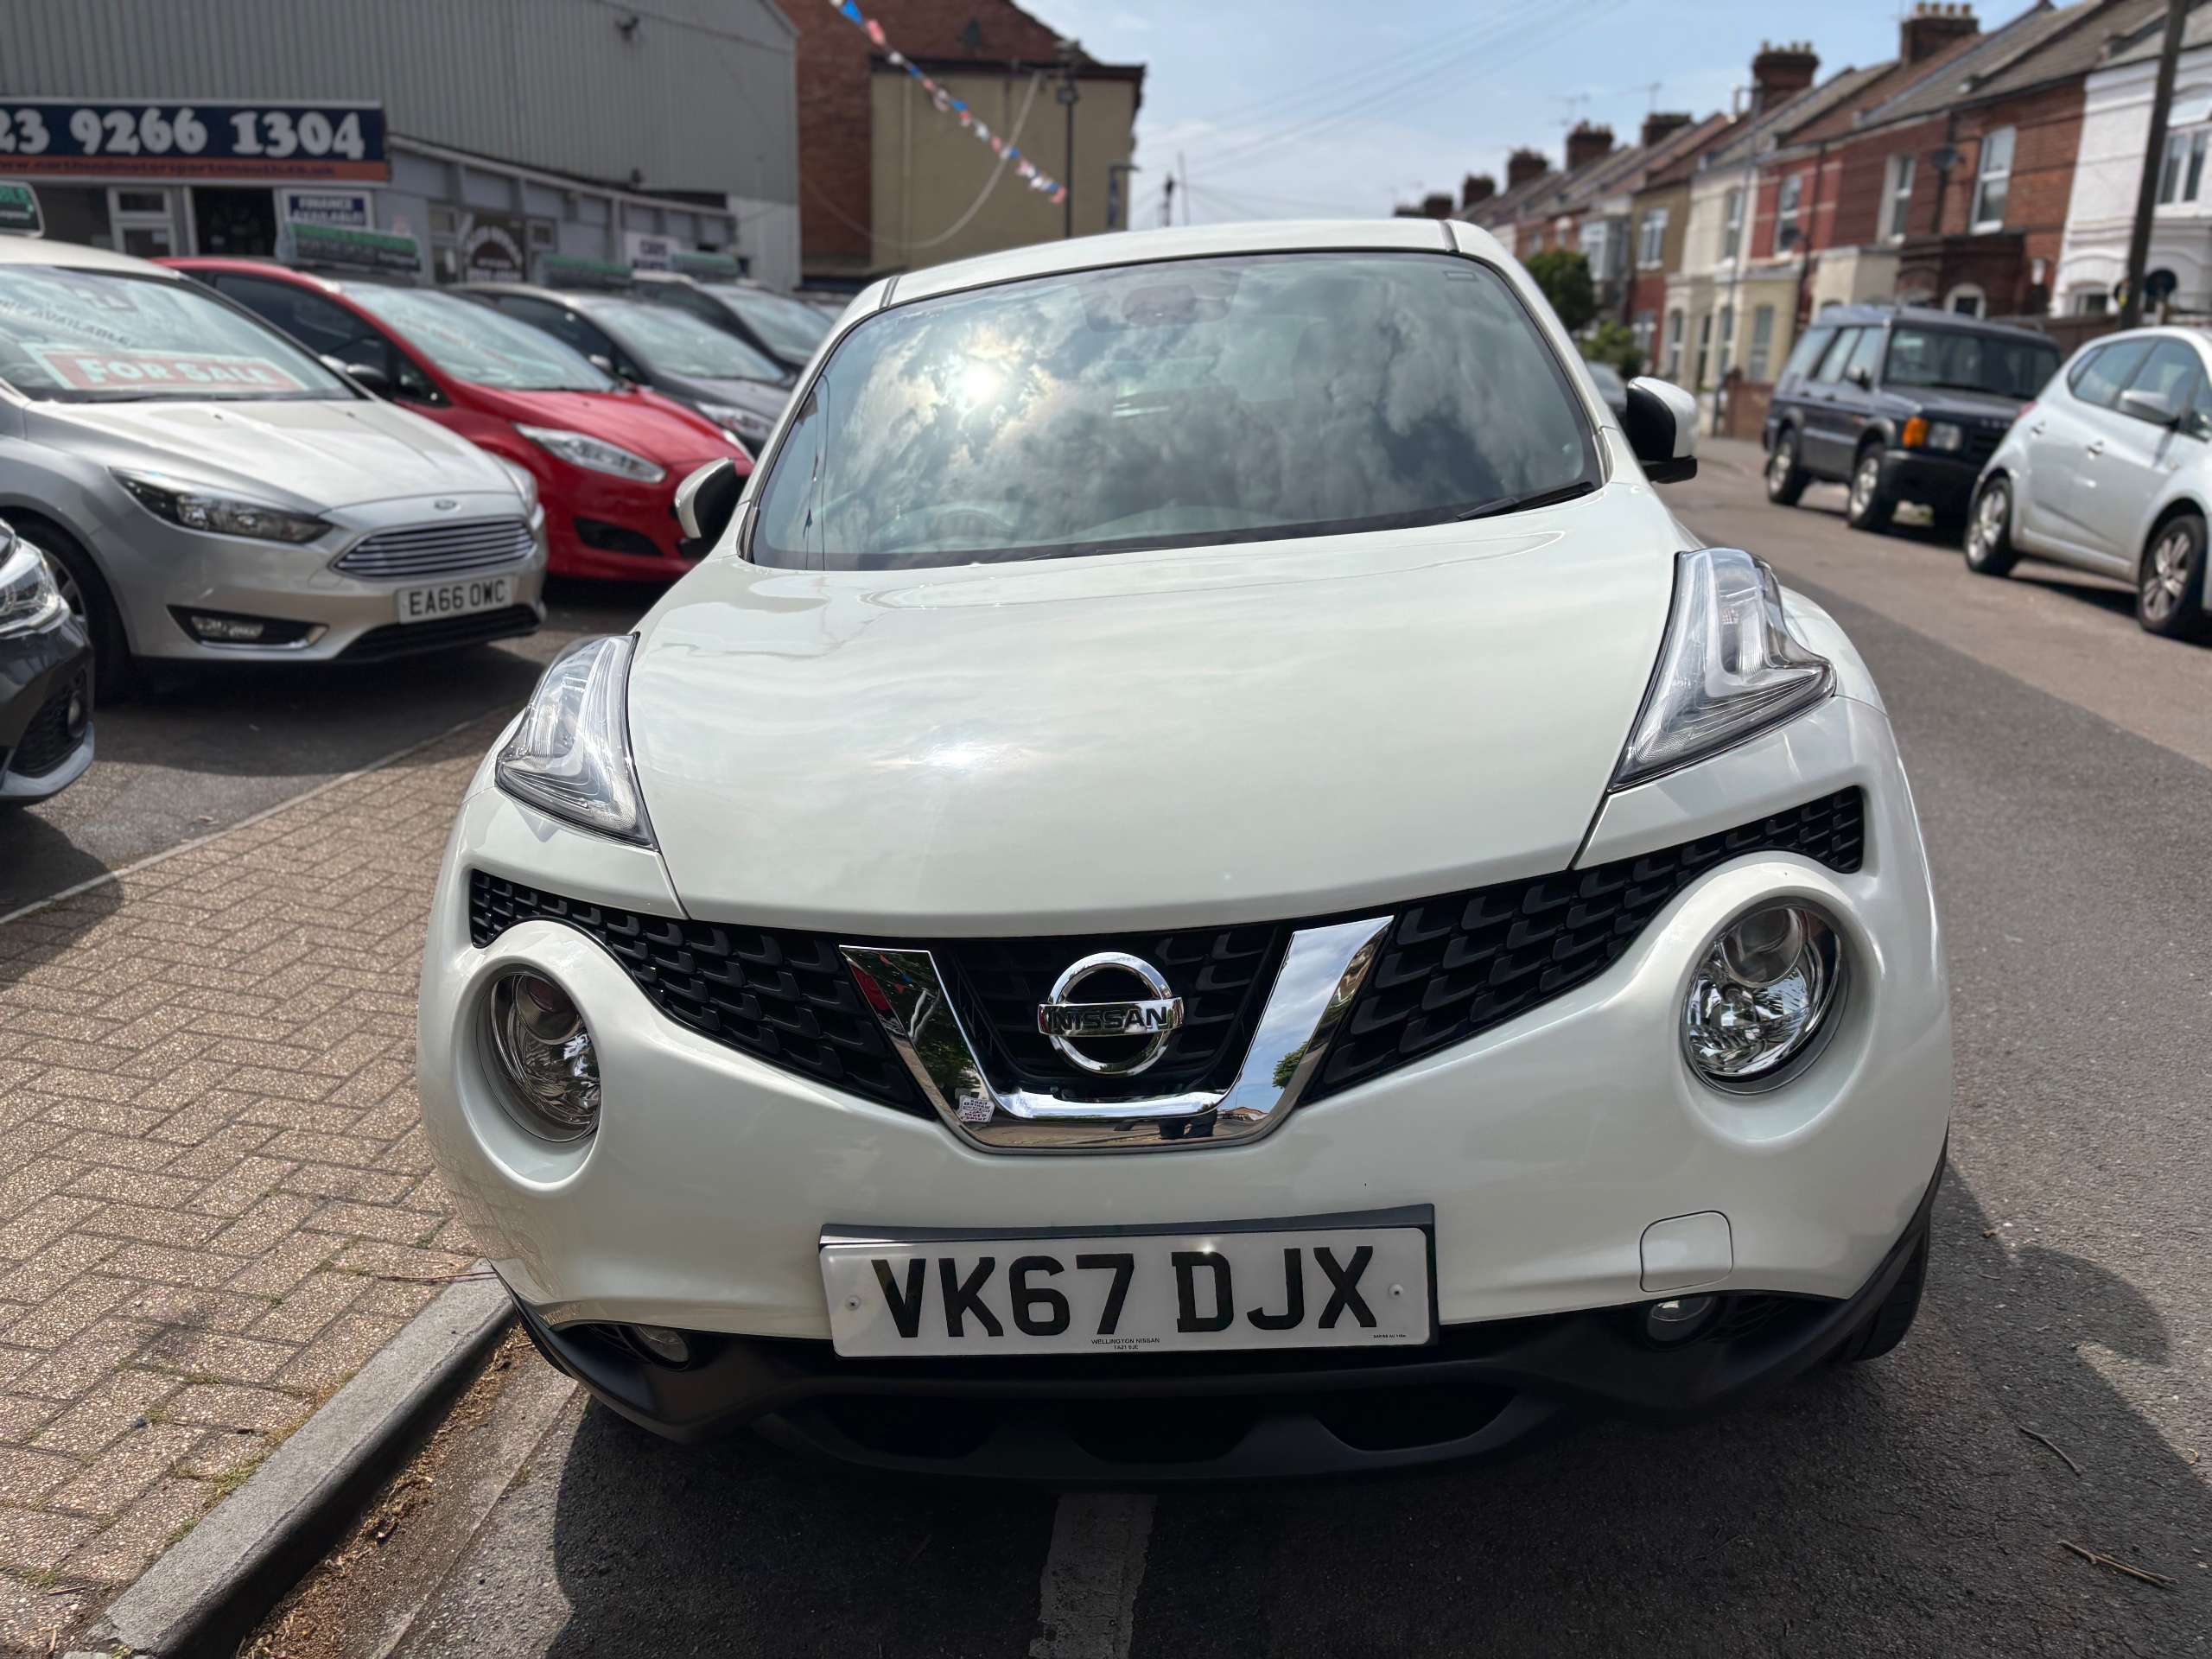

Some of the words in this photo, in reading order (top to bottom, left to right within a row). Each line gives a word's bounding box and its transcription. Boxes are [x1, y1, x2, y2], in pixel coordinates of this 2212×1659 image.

[69, 107, 208, 156] 9266
[229, 111, 366, 161] 1304
[298, 197, 353, 209] FINANCE
[75, 357, 173, 383] FOR
[173, 361, 277, 385] SALE
[409, 585, 465, 616] EA66
[469, 580, 505, 607] OWC
[1050, 1005, 1167, 1032] NISSAN
[869, 1253, 1135, 1339] VK67
[1170, 1244, 1377, 1333] DJX
